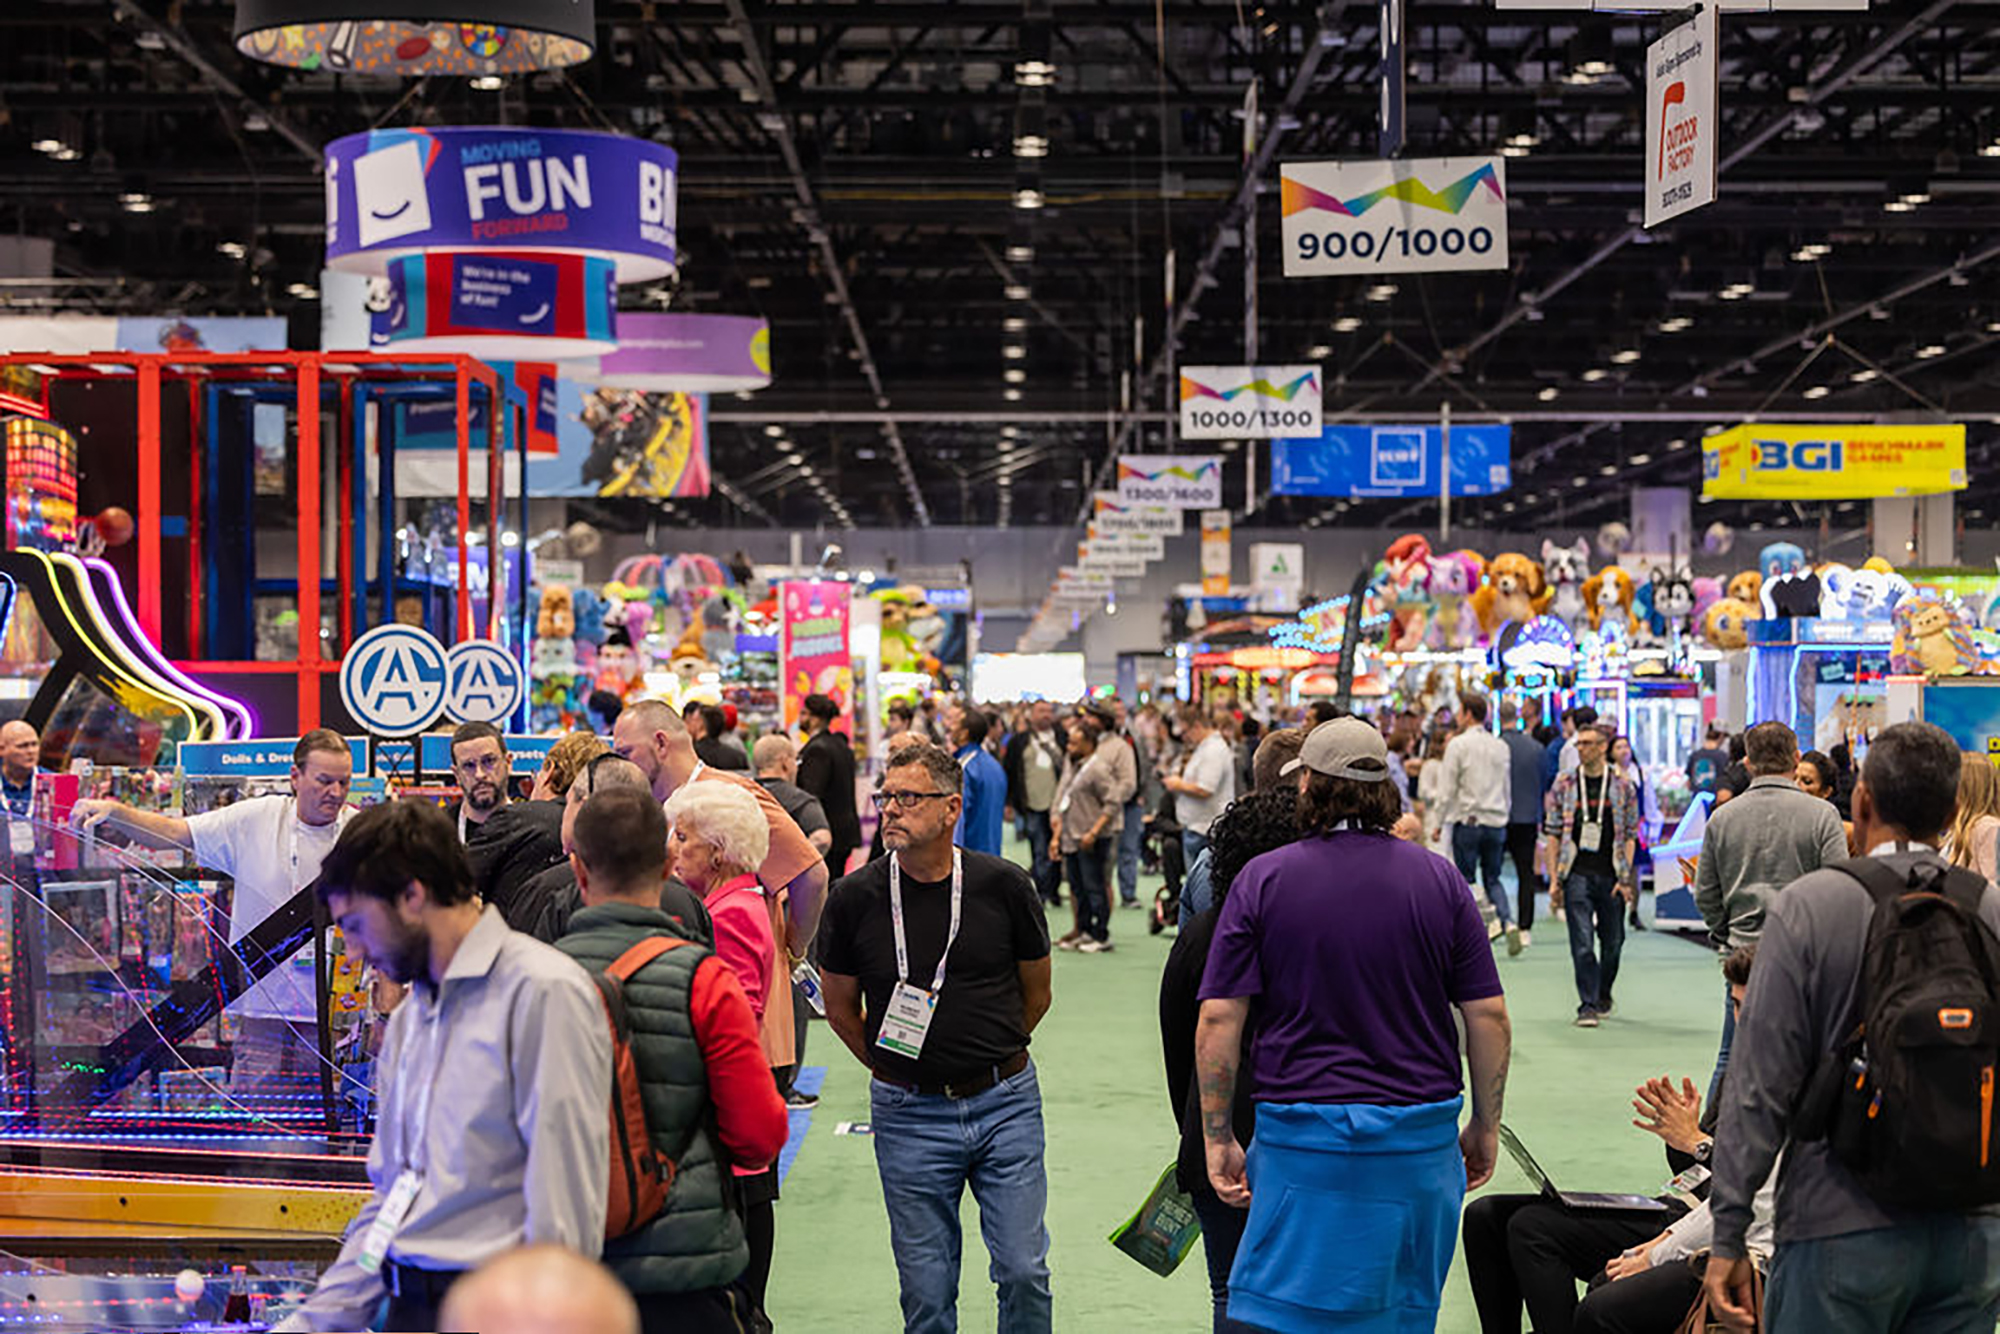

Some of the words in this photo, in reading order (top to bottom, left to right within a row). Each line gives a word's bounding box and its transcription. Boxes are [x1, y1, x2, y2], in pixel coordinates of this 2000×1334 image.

[1666, 116, 1698, 152] OUTDOOR
[461, 140, 541, 164] MOVING
[1668, 146, 1694, 171] FACTORY
[464, 155, 592, 220] FUN
[472, 214, 568, 239] FORWARD
[1298, 226, 1493, 263] 900/1000
[1190, 410, 1312, 430] 1000/1300
[1757, 441, 1842, 471] BGI
[222, 754, 252, 764] Dolls
[256, 752, 266, 764] &
